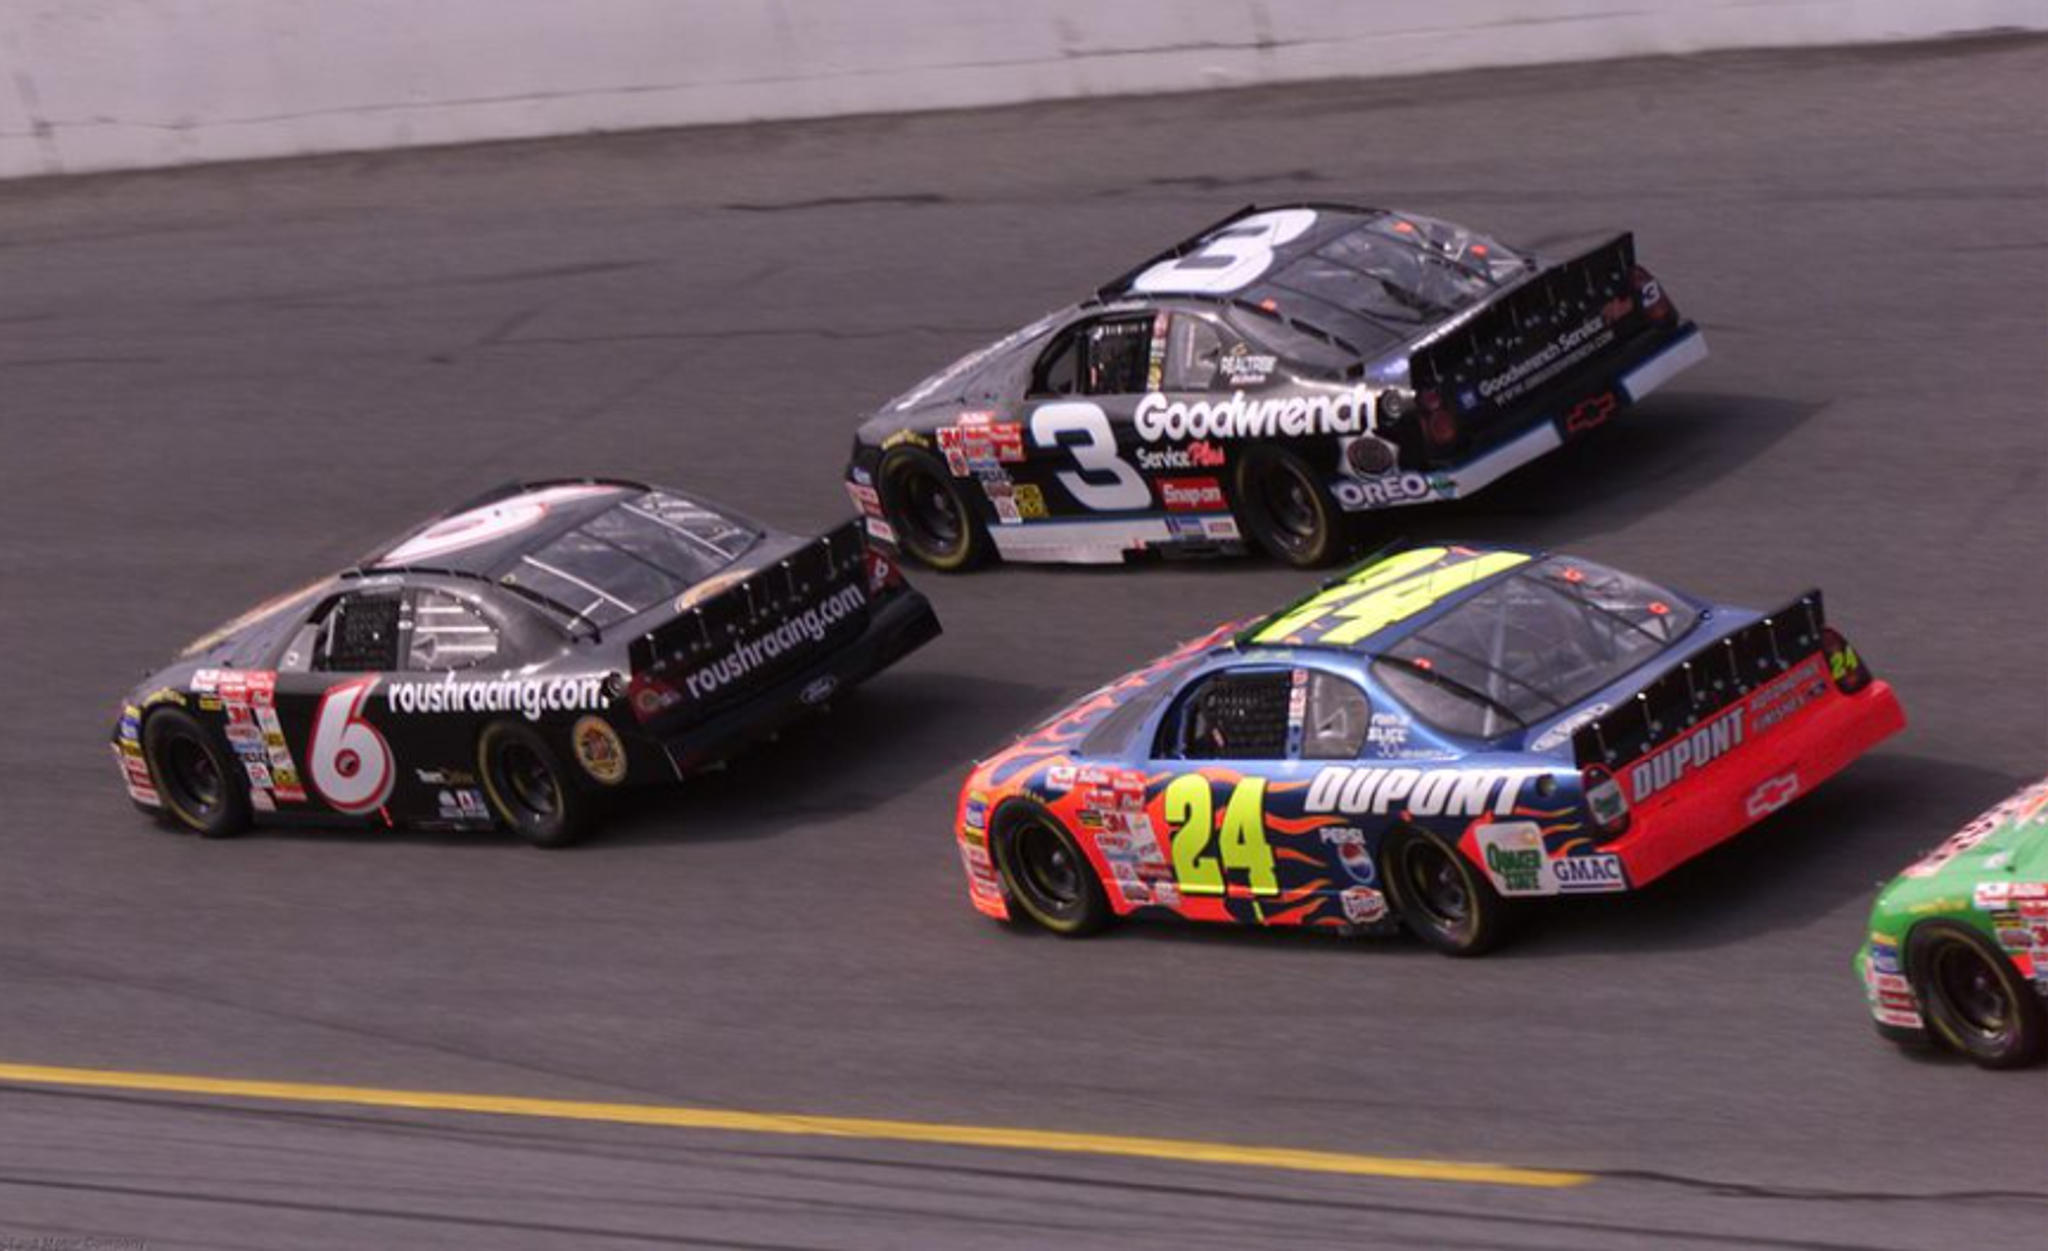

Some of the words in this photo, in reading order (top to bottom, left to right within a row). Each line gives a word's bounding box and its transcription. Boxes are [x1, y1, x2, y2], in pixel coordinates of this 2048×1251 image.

[1130, 209, 1318, 294] 3
[1642, 281, 1661, 308] 3
[1134, 383, 1376, 442] Goodwrench
[1032, 401, 1152, 510] 3
[1136, 446, 1190, 469] Service
[1339, 473, 1427, 505] OREO
[874, 558, 889, 579] 6
[686, 582, 866, 699] roushracing.com
[1829, 645, 1858, 680] 24
[387, 670, 610, 721] roushracing.com
[306, 672, 396, 815] 6
[1633, 706, 1745, 803] DUPONT
[1304, 766, 1528, 817] DUPONT
[1164, 773, 1279, 895] 24
[1320, 828, 1366, 844] PEPSI
[1486, 841, 1542, 873] QUAKER
[1553, 858, 1620, 882] GMAC
[1505, 869, 1541, 890] STATE
